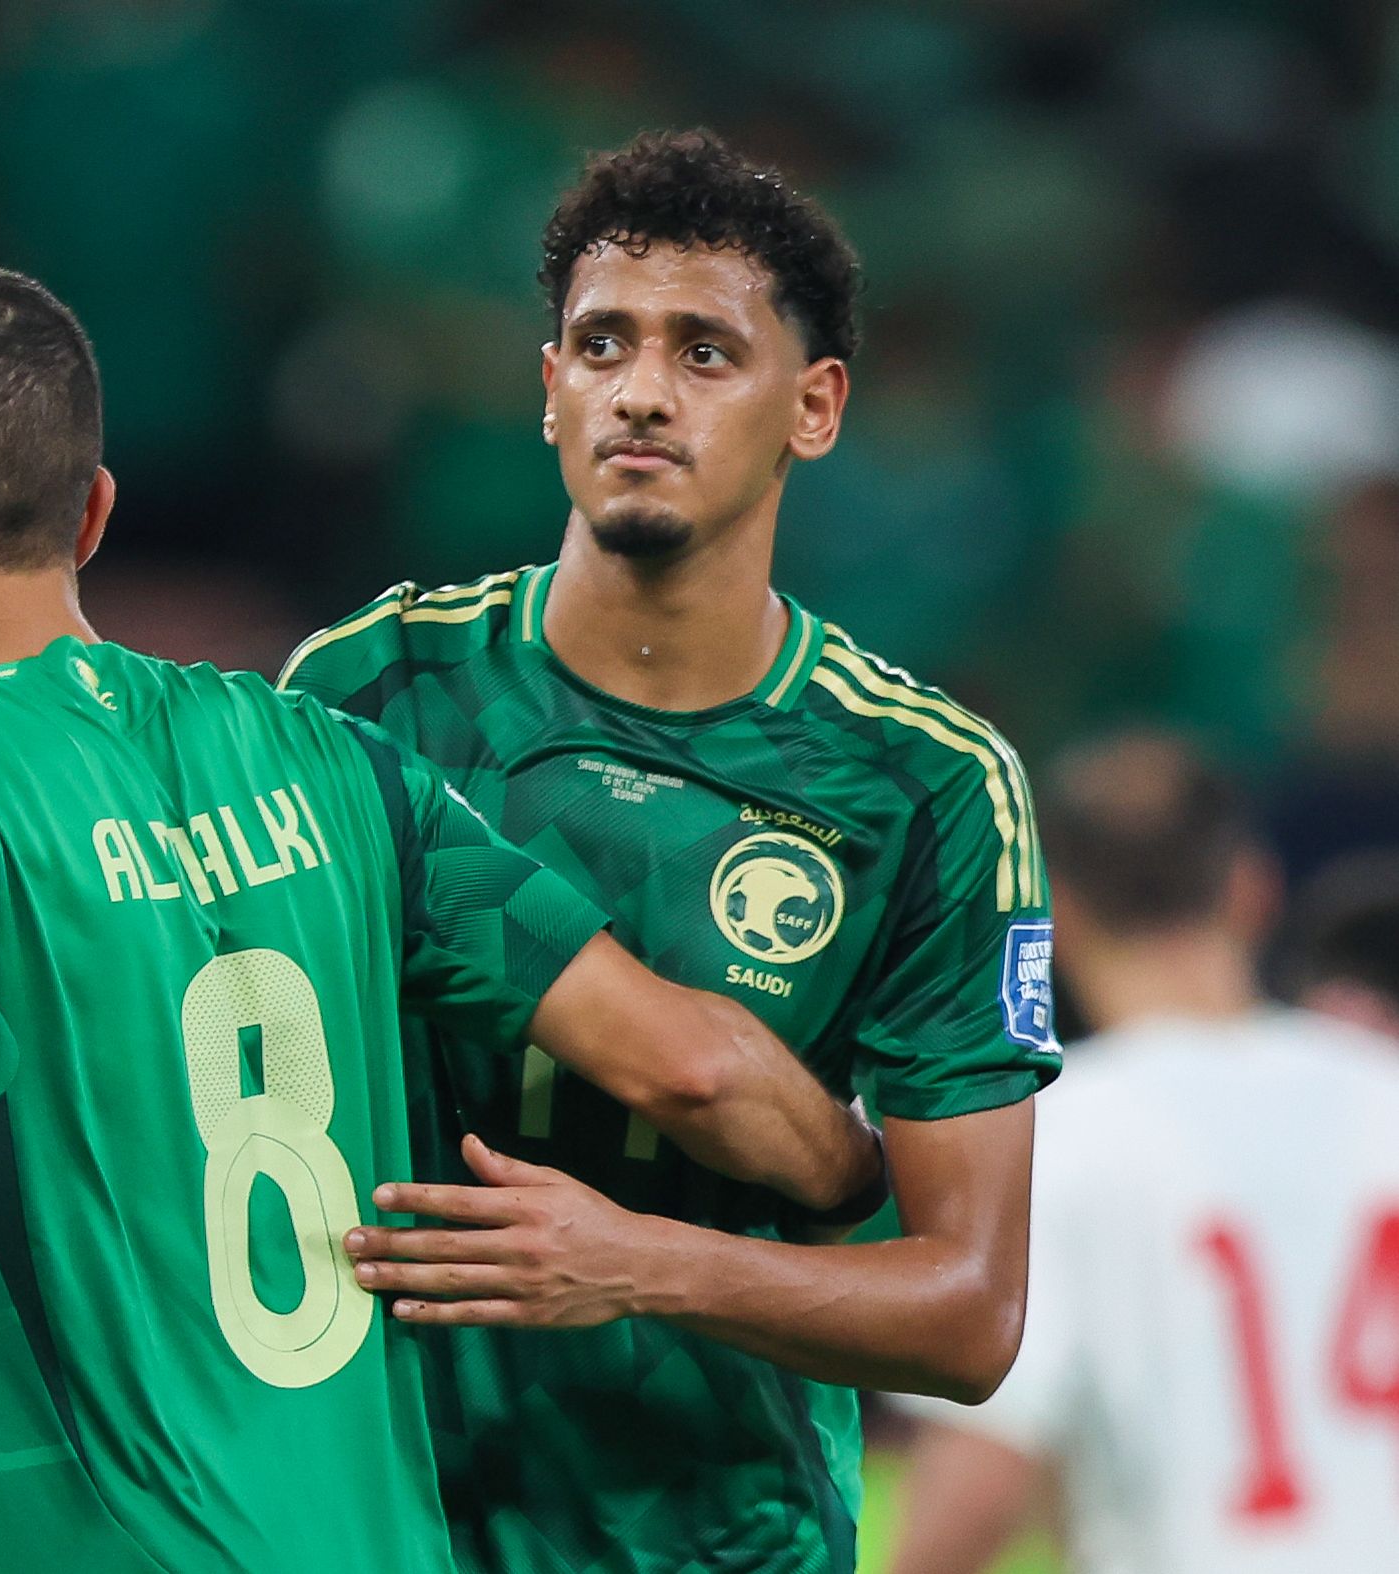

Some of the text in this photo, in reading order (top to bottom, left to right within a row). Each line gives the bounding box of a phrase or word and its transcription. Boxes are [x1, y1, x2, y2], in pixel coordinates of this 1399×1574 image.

[577, 759, 604, 773] SAUDI
[739, 803, 843, 848] السعودية
[776, 912, 814, 931] SAFF
[725, 964, 794, 998] SAUDI
[181, 948, 375, 1389] 8
